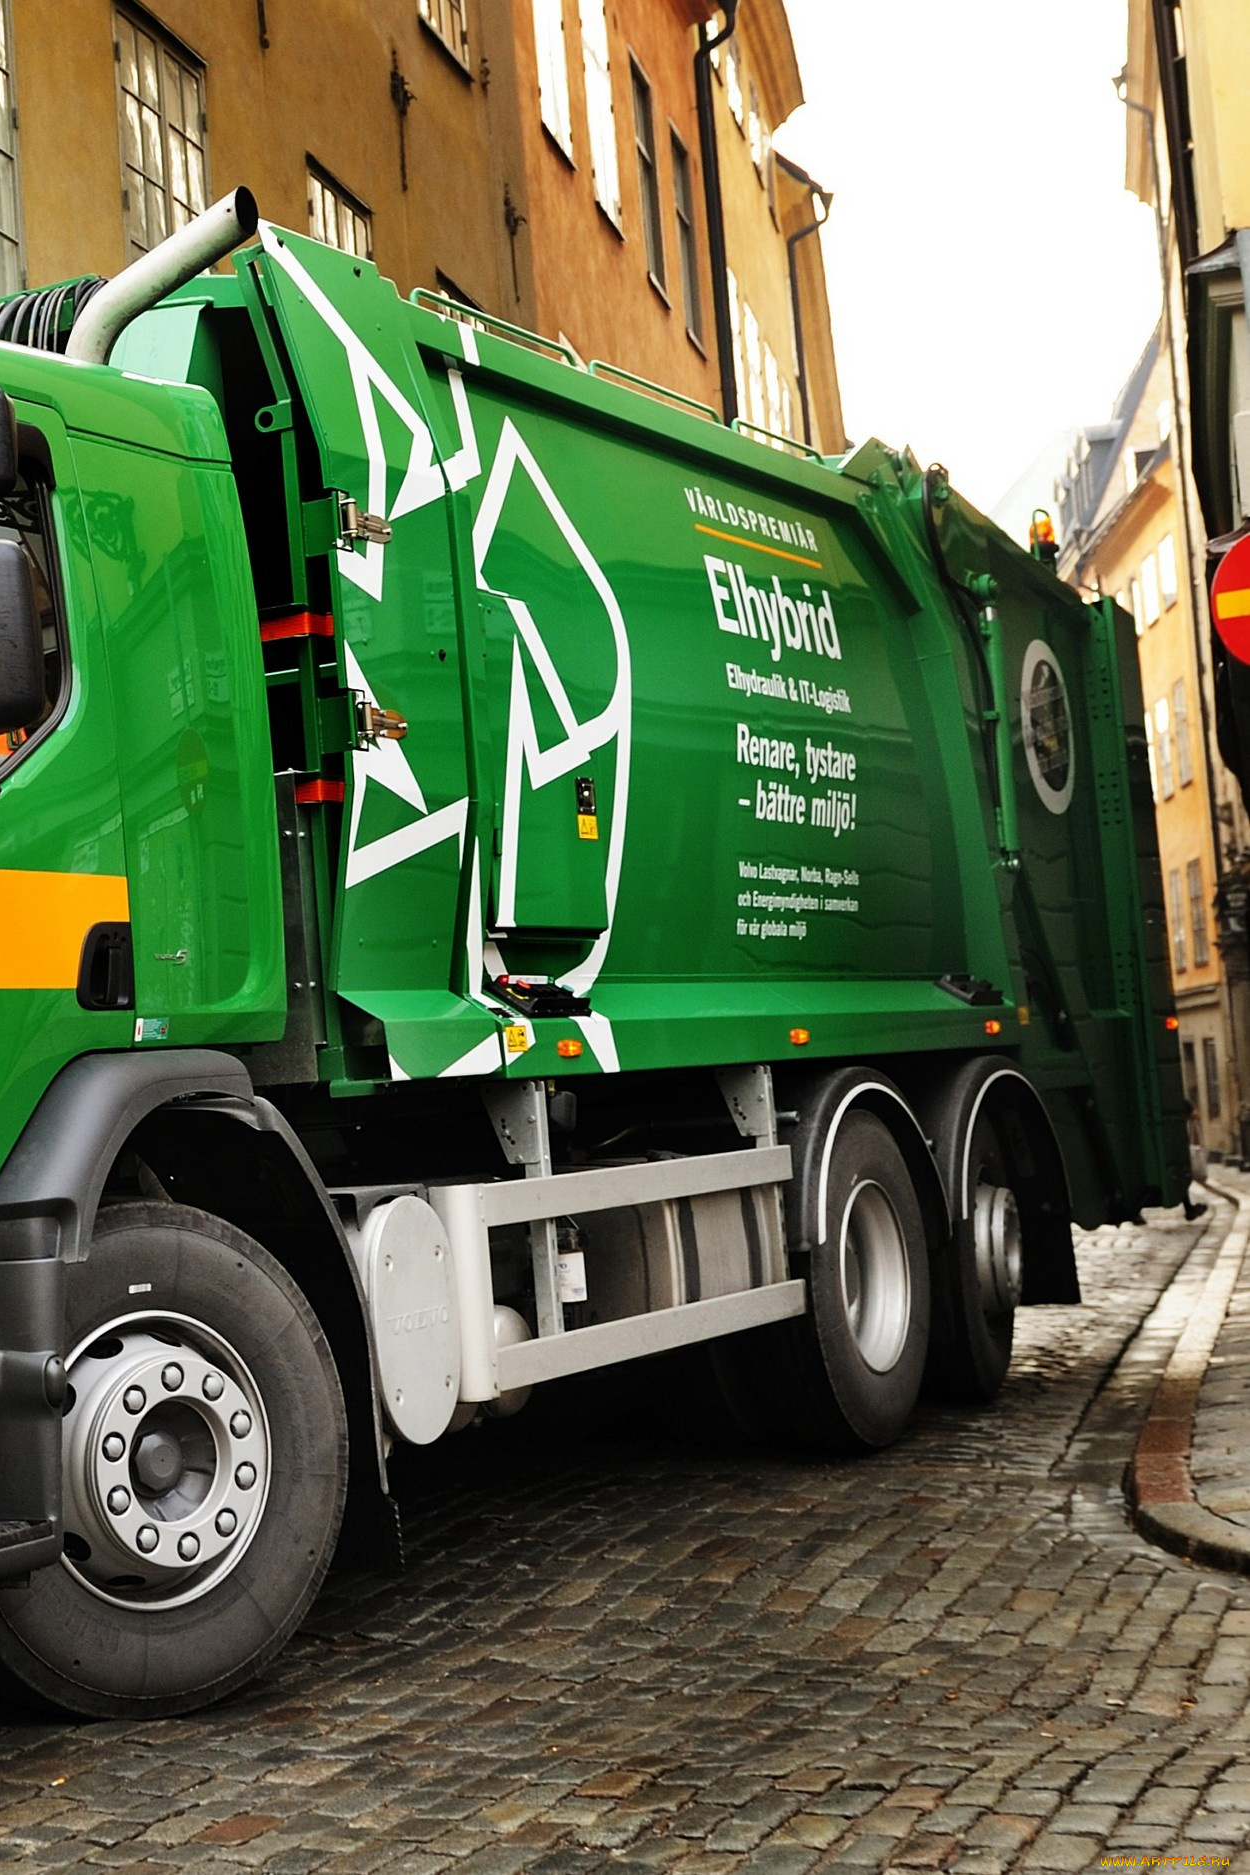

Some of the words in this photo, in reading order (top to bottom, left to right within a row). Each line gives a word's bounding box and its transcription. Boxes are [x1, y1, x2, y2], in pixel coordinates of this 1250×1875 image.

[684, 486, 818, 552] VÄRLDSPREMIÄR
[703, 554, 842, 662] Elhybrid
[726, 662, 788, 697] Elhydraulik
[788, 677, 799, 702] &
[798, 679, 852, 714] IT-Logistik
[736, 723, 800, 779] Renare,
[805, 737, 856, 784] tystare
[811, 789, 857, 838] miljö!
[386, 1304, 450, 1336] VOLVO
